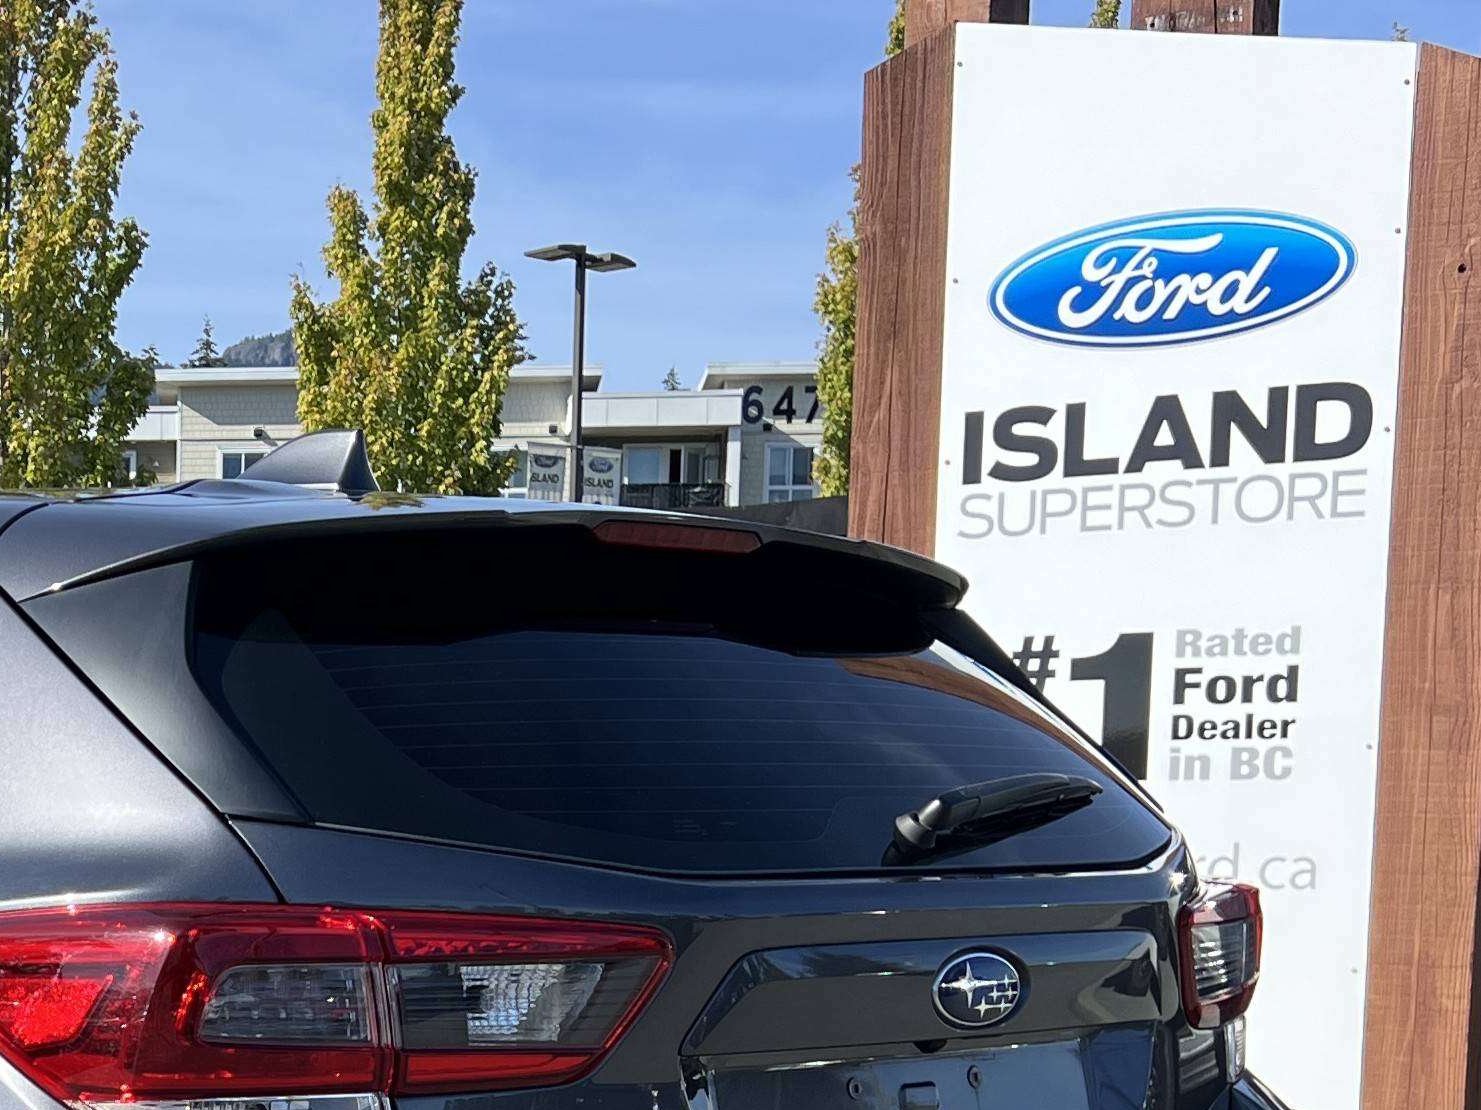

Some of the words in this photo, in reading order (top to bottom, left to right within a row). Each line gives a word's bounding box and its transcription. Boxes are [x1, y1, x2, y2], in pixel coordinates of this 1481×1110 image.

[1057, 231, 1280, 329] Ford
[962, 381, 1373, 486] ISLAND
[957, 468, 1368, 540] SUPERSTORE
[1175, 625, 1302, 658] Rated
[1172, 664, 1299, 705] Ford
[1170, 713, 1296, 741] Dealer
[1168, 748, 1211, 782] in
[1229, 746, 1293, 782] BC
